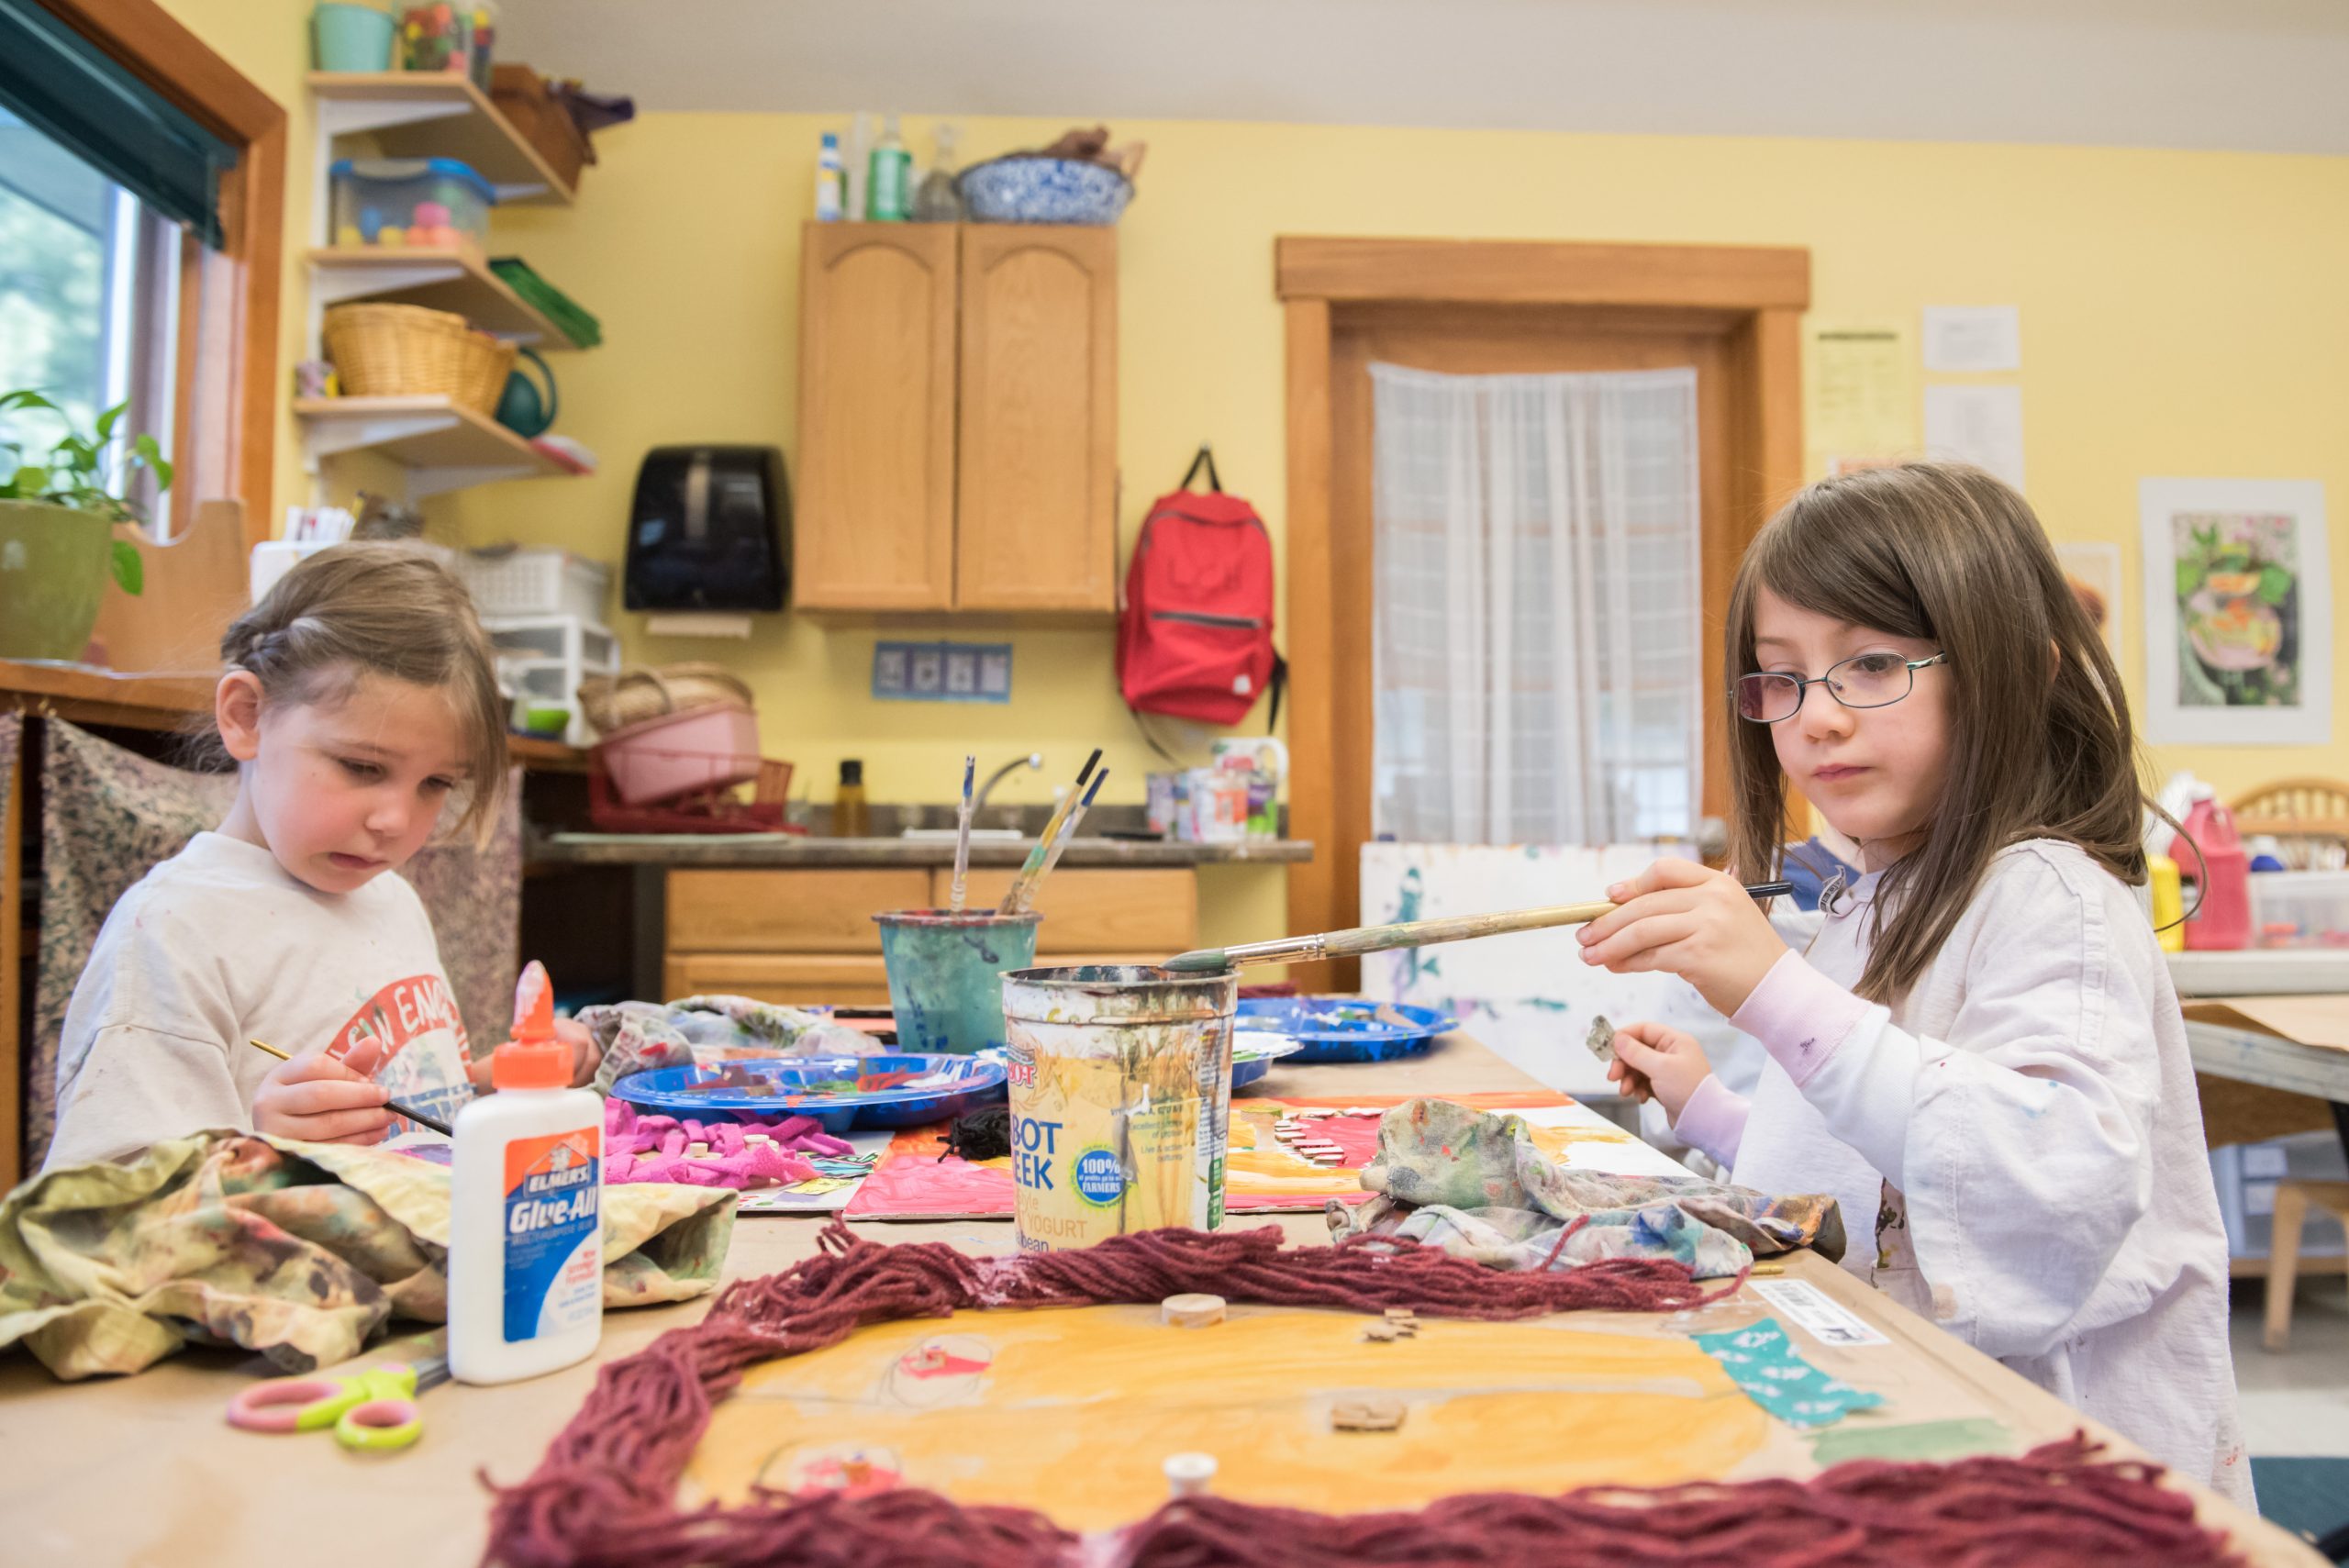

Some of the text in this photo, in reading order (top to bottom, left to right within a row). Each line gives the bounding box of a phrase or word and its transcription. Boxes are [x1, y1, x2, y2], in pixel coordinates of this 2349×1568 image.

[1011, 1113, 1063, 1155] BOT
[1014, 1149, 1054, 1191] EEK
[1082, 1158, 1120, 1174] 100%
[1082, 1182, 1121, 1193] FARMERS
[1027, 1212, 1088, 1240] YOGURT
